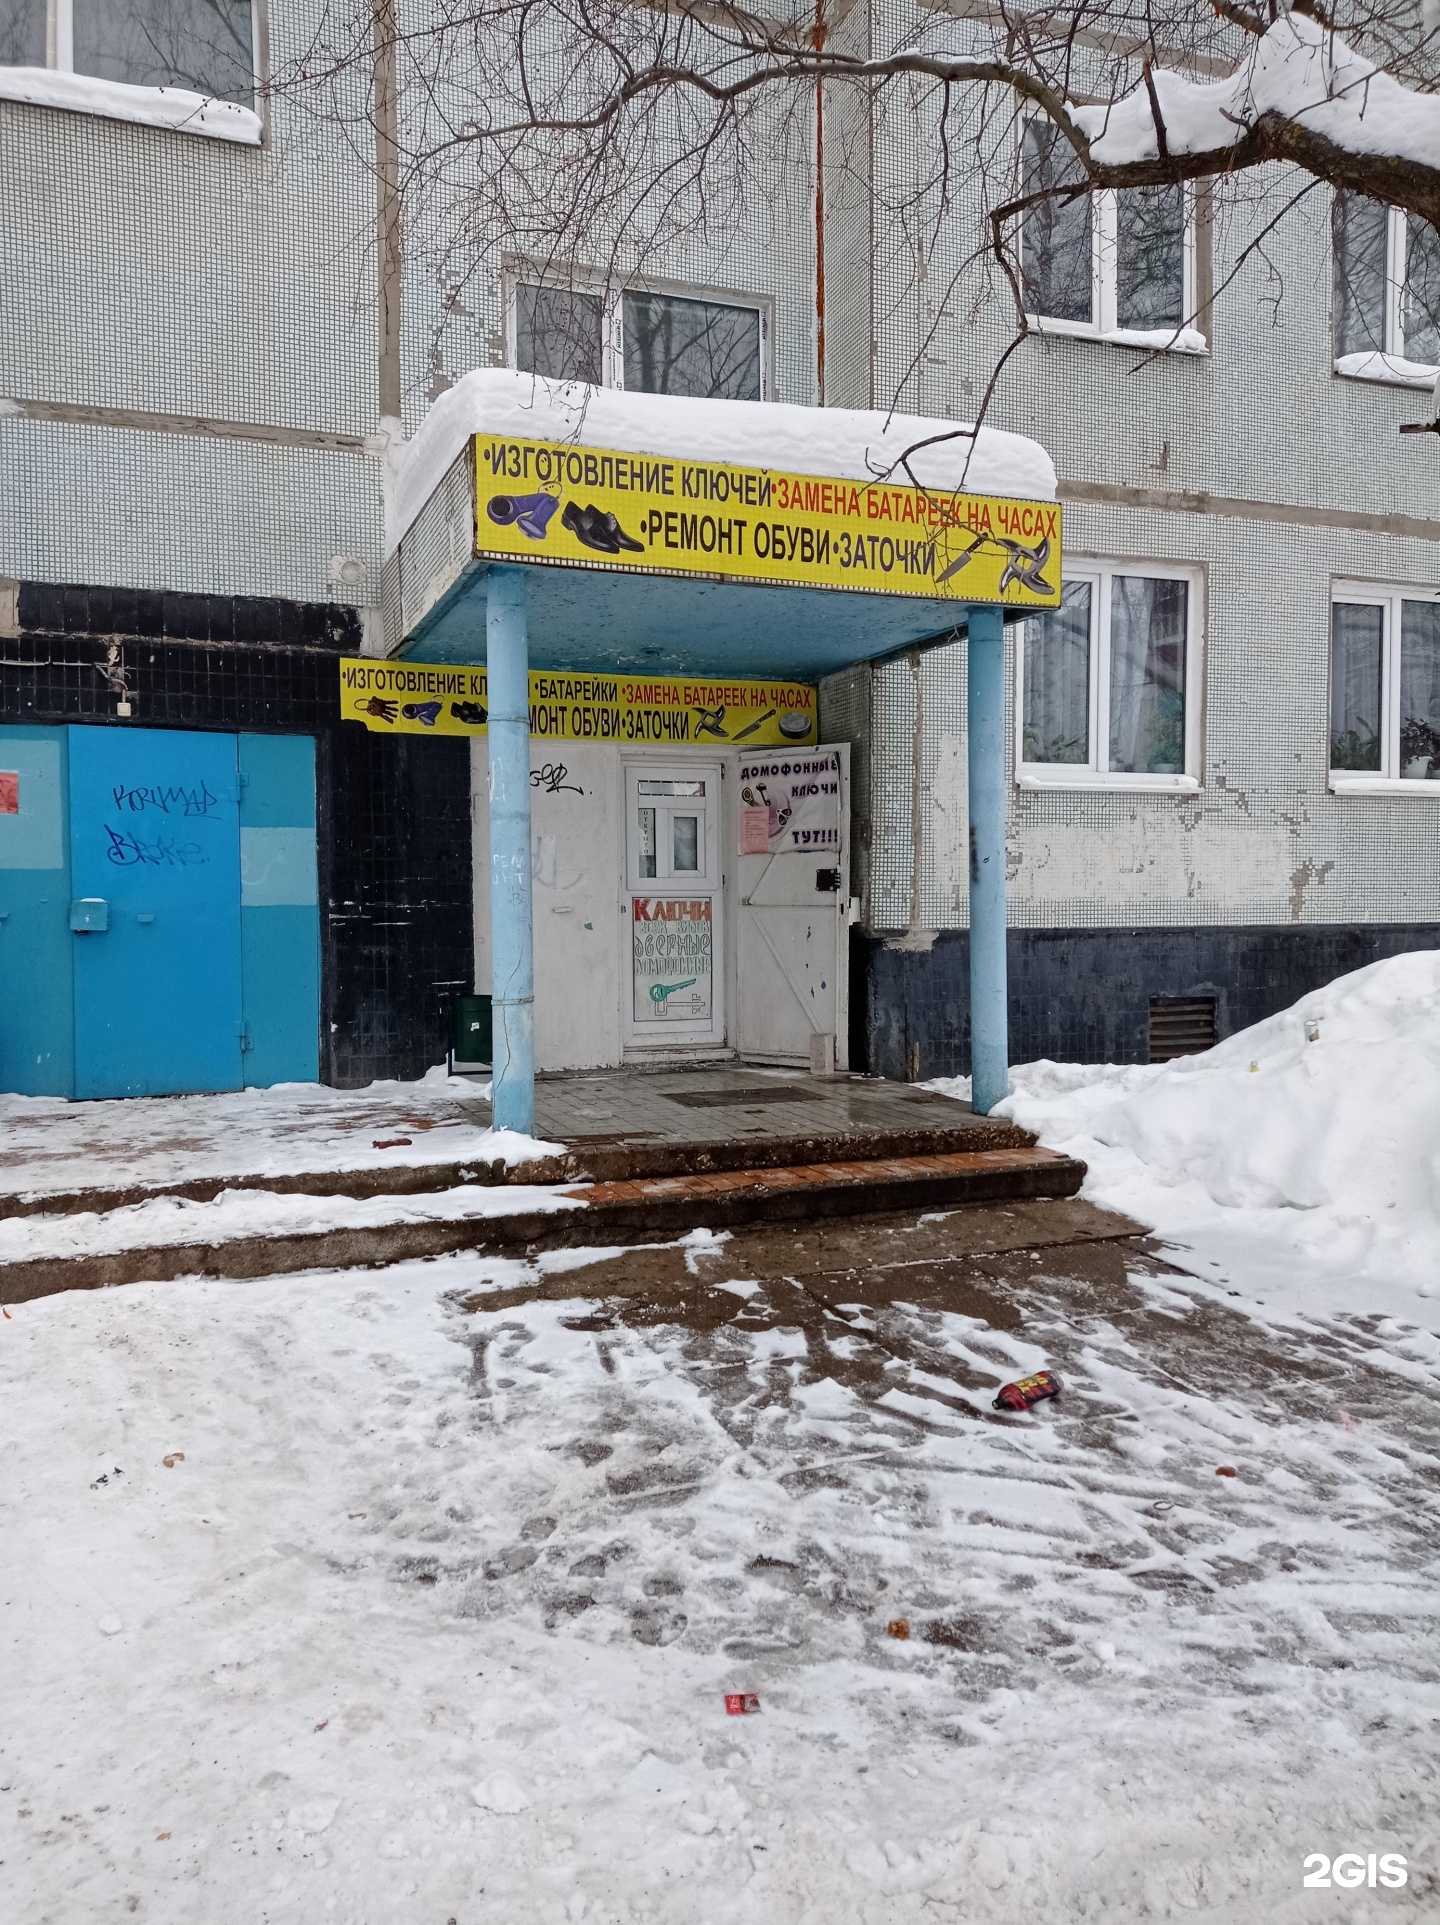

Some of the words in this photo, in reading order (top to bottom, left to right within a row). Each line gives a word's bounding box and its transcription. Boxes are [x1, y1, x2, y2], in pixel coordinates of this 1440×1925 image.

[491, 443, 675, 496] ИЗГОТОВЛЕНИЕ
[682, 465, 771, 508] КЛЮЧЕЙ
[778, 478, 861, 518] ЗАМЕНА
[967, 500, 990, 531] НА
[997, 506, 1057, 539] ЧАСАХ
[648, 509, 747, 556] РЕМОНТ
[753, 521, 830, 565] ОБУВИ
[839, 531, 935, 577] ЗАТОЧКИ
[346, 666, 466, 695] ИЗГОТОВЛЕНИЕ
[539, 675, 618, 702] БАТАРЕЙКИ
[626, 683, 681, 706] ЗАМЕНА
[683, 685, 746, 708] БАТАРЕЕК
[750, 688, 768, 708] НА
[771, 688, 813, 709] ЧАСАХ
[529, 704, 567, 736] МОНТ
[572, 706, 620, 738] ОБУВИ
[626, 709, 689, 740] ЗАТОЧКИ
[792, 783, 838, 798] КЛЮЧИ
[792, 829, 838, 845] ТУТ!!!
